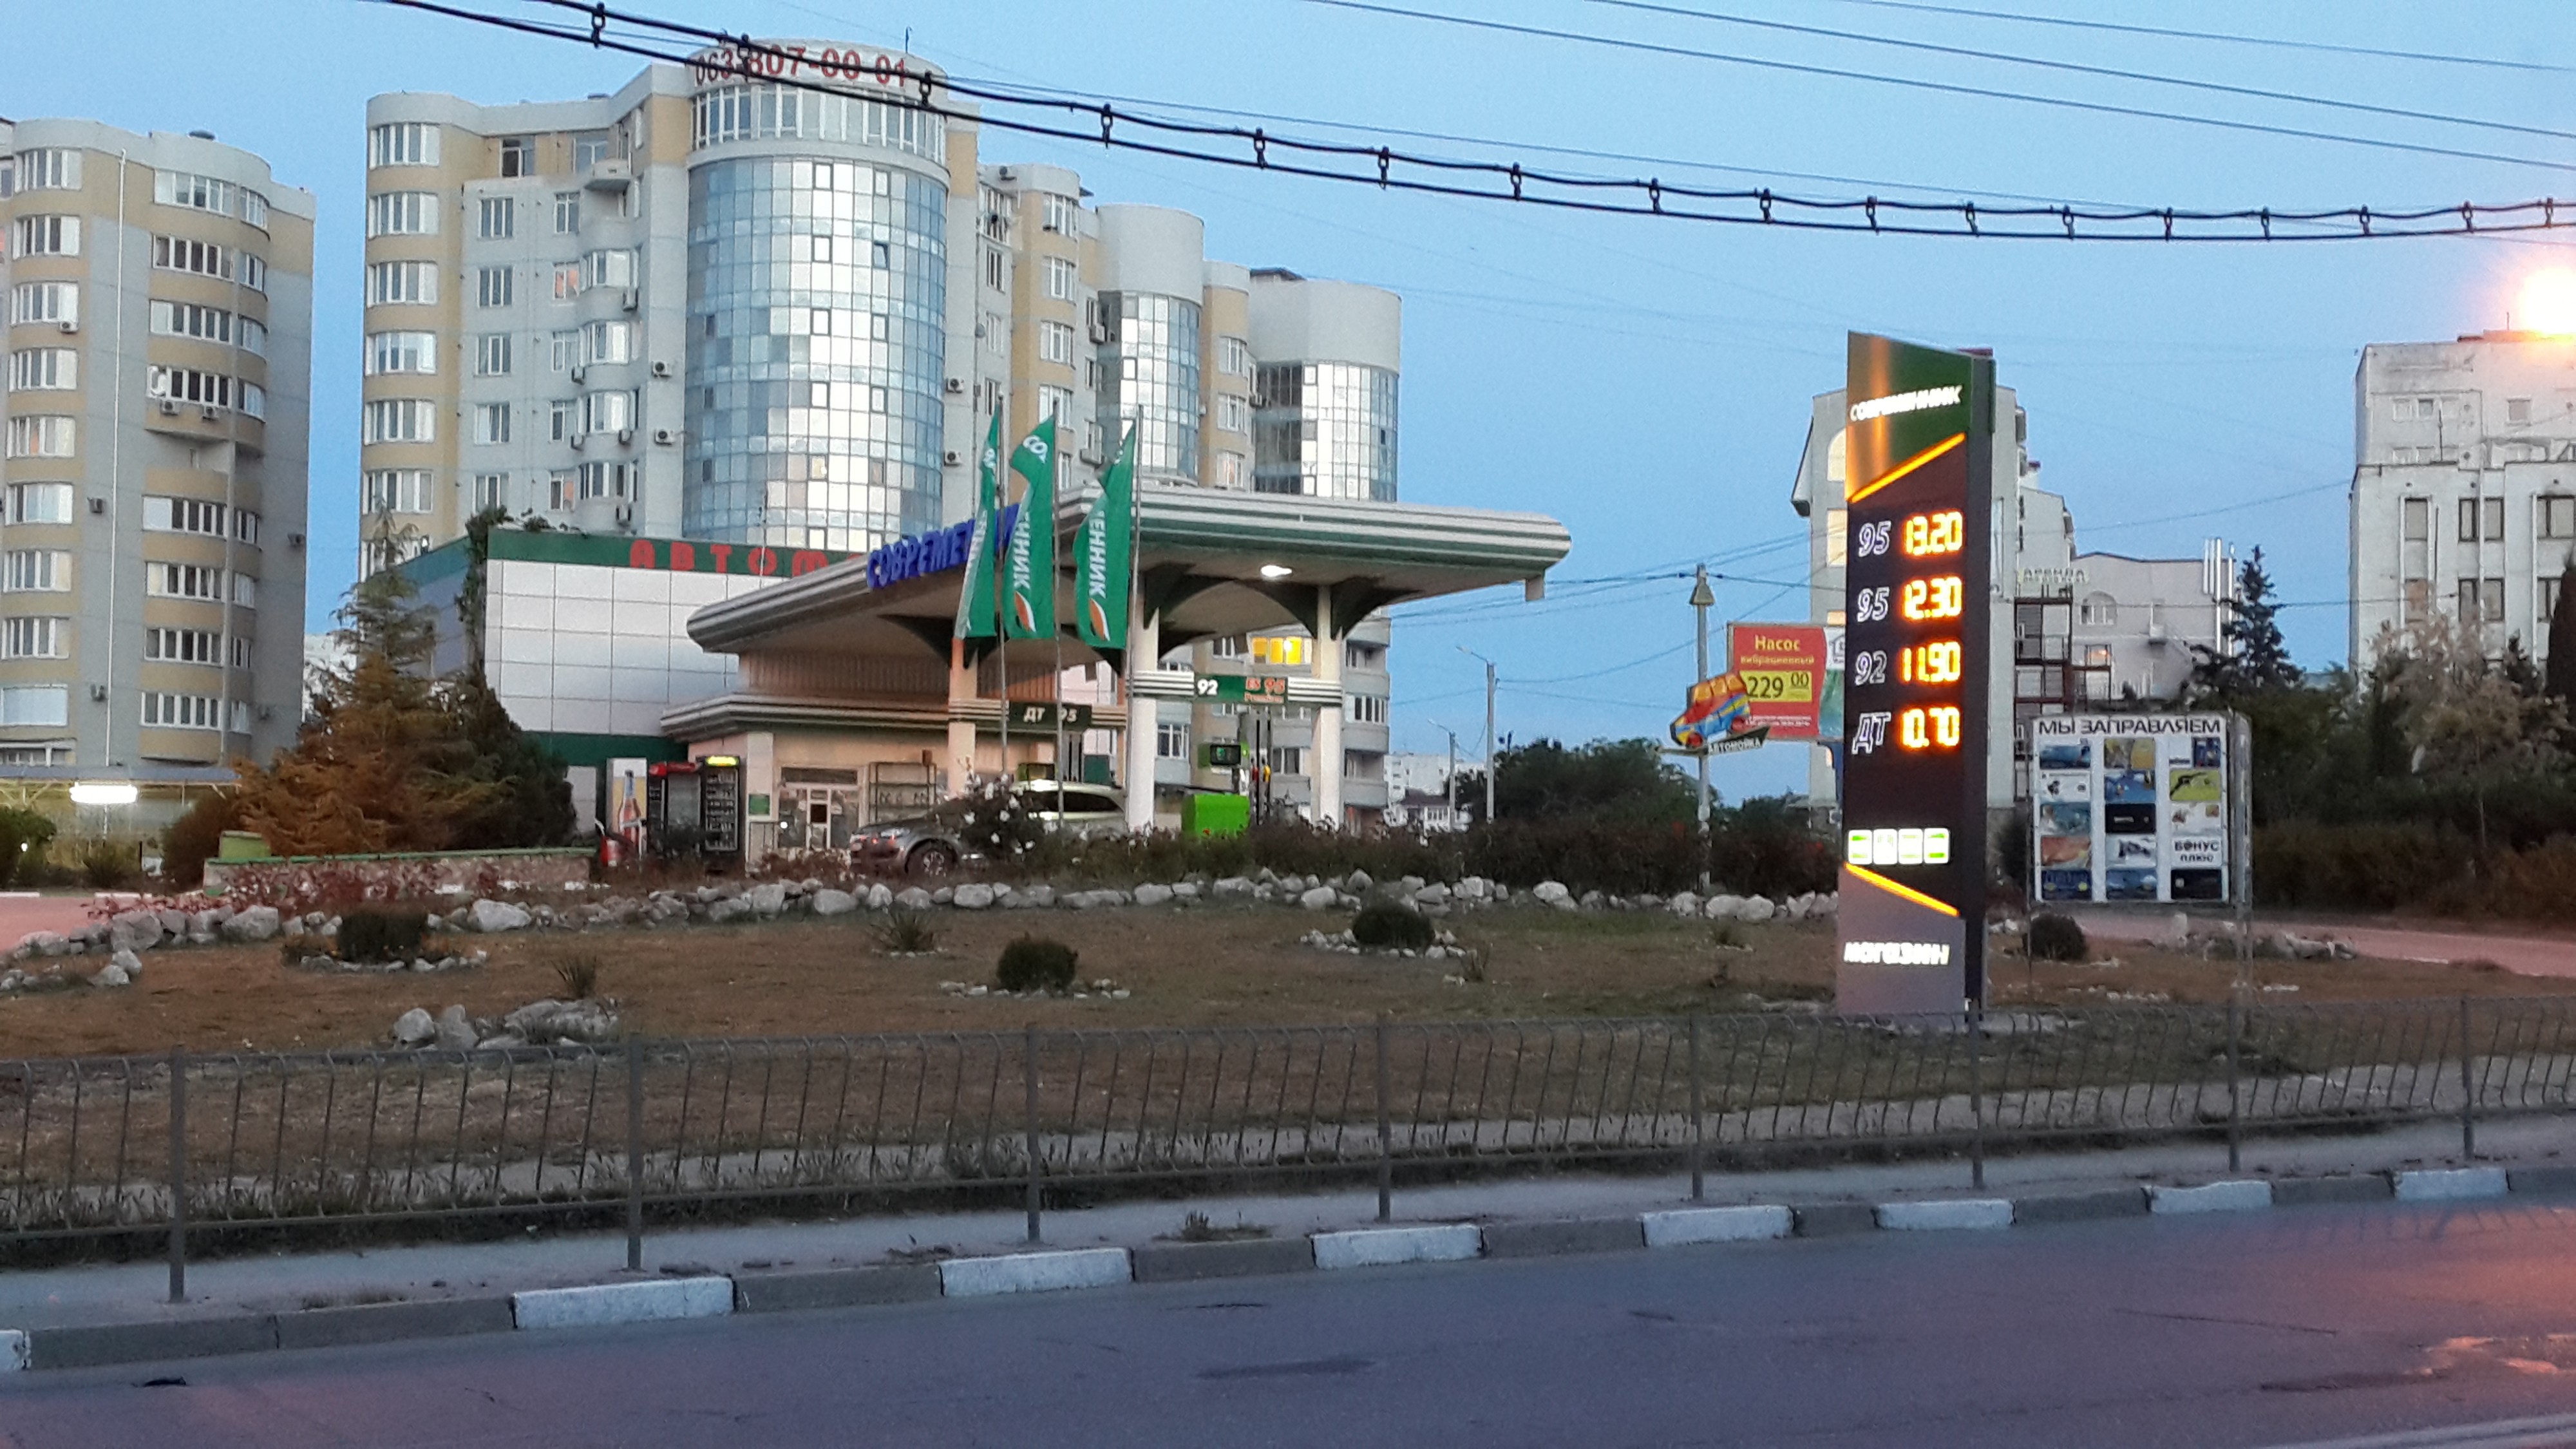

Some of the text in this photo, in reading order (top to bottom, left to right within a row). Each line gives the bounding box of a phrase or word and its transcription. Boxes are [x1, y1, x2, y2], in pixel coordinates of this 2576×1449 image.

[1859, 520, 1891, 556] 95
[630, 540, 864, 576] АВТОМ
[1857, 577, 1962, 622] 95 12.30
[1754, 635, 1801, 651] Насос
[1855, 642, 1961, 686] 92 11.90
[1198, 679, 1218, 695] 92
[1747, 672, 1809, 698] 229 00
[1023, 707, 1045, 722] ДТ
[2039, 719, 2220, 734] МЫ ЗАПРАВЛЯЕМ
[1852, 712, 1891, 755] ДТ
